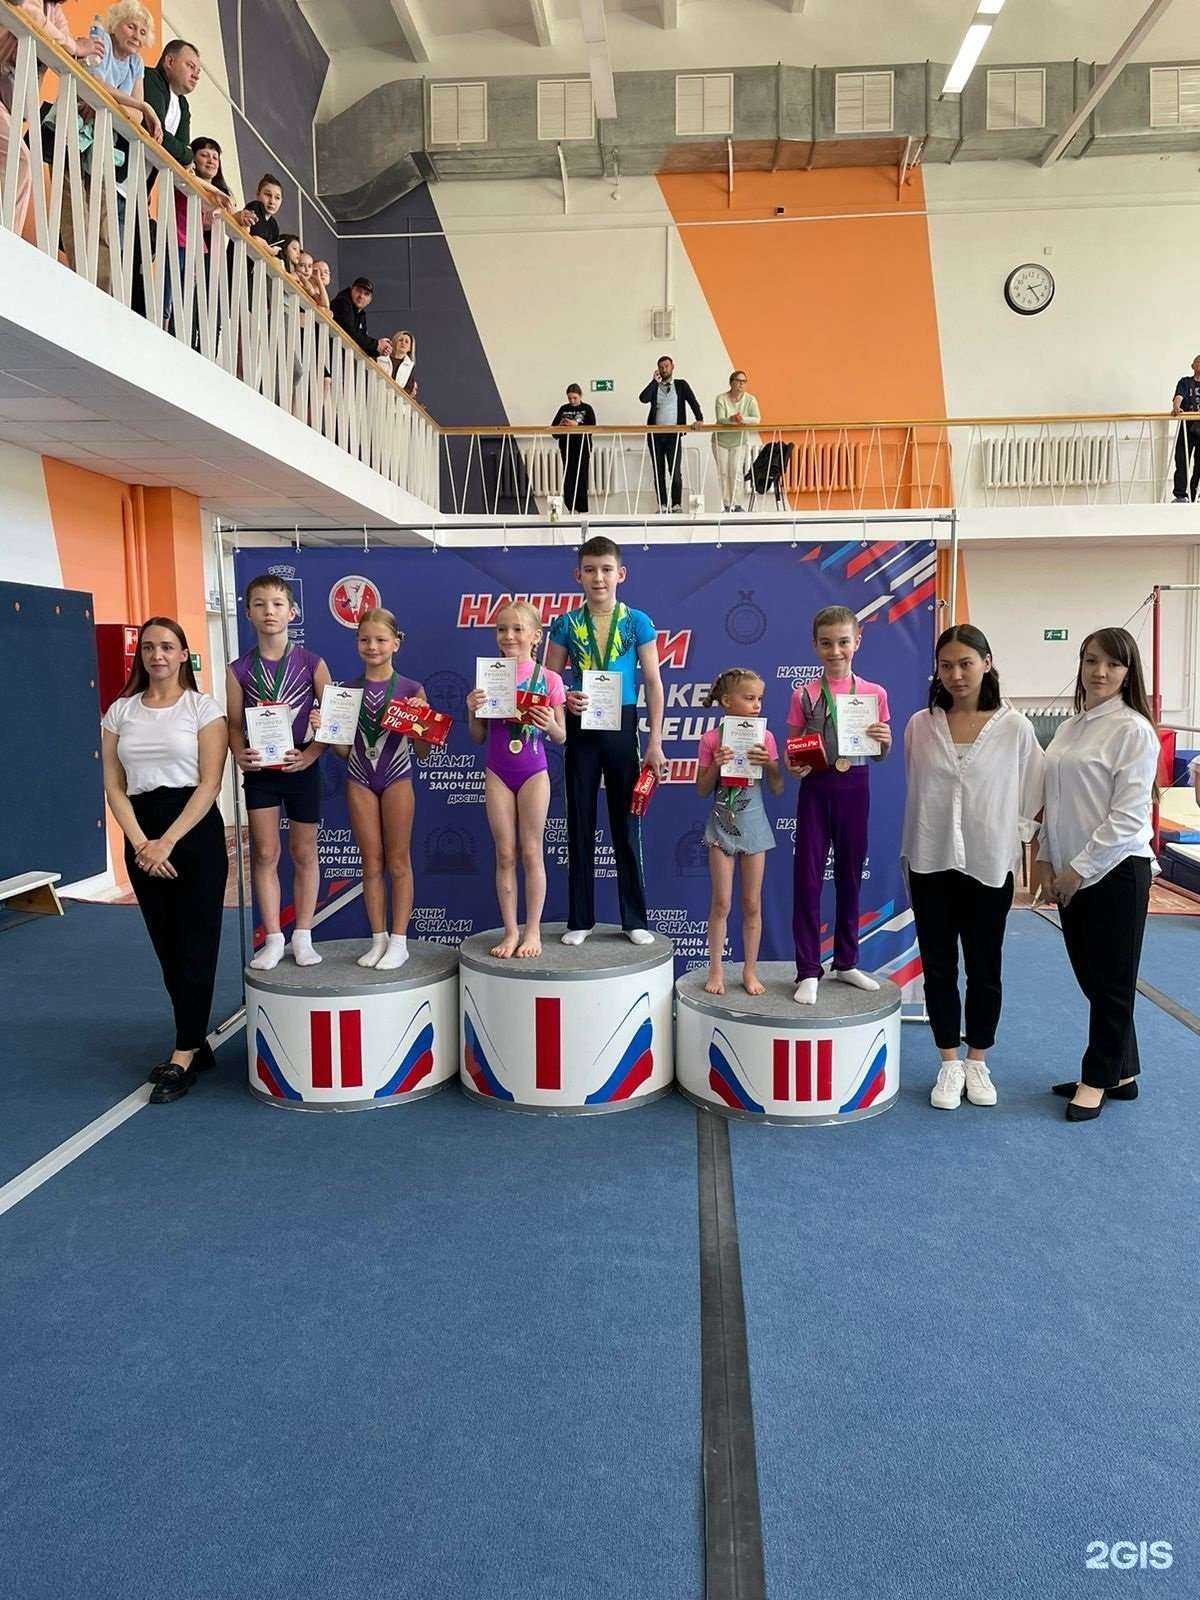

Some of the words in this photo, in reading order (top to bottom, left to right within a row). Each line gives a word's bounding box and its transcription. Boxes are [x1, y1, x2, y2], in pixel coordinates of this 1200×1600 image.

[776, 665, 825, 678] НАЧНИ
[387, 705, 419, 722] Choco
[383, 715, 402, 729] Pie
[429, 755, 475, 768] НАМИ
[419, 772, 427, 780] И
[429, 771, 463, 780] СТАНЬ
[317, 829, 352, 842] АМИ
[547, 846, 556, 854] И
[409, 908, 446, 919] АЧНИ
[428, 919, 473, 932] НАМИ
[310, 1010, 363, 1088] II
[773, 1039, 833, 1101] III
